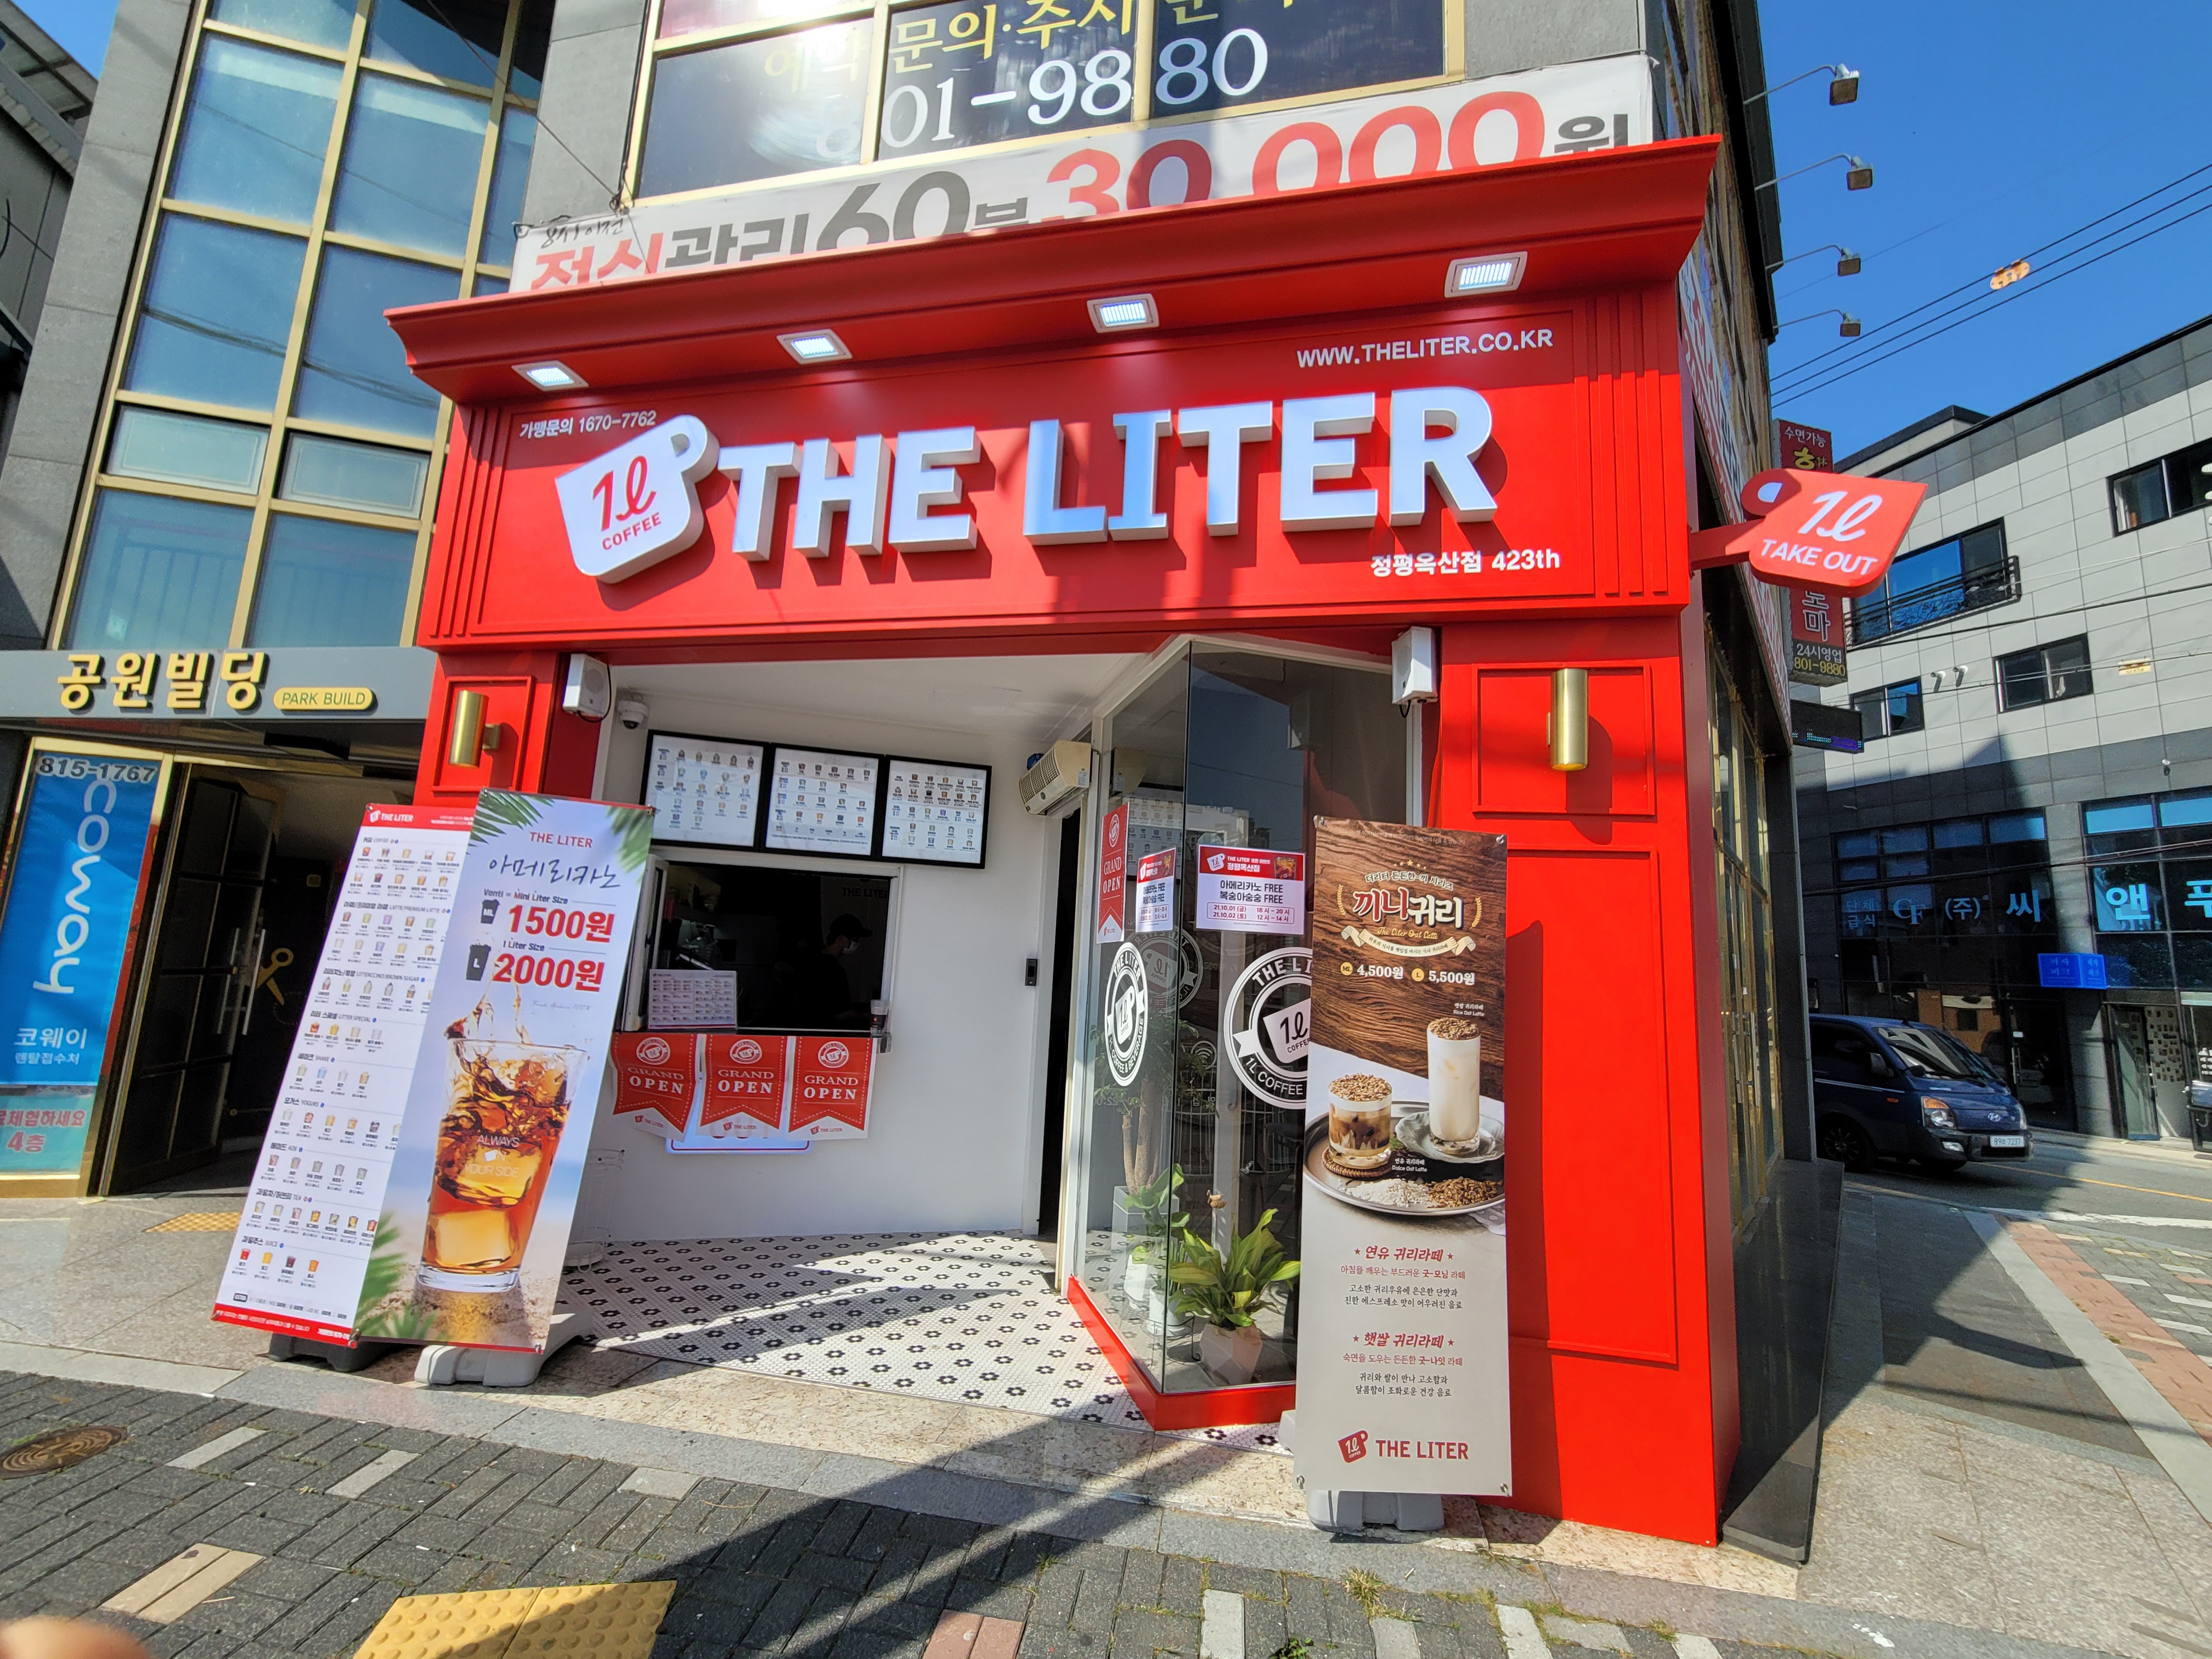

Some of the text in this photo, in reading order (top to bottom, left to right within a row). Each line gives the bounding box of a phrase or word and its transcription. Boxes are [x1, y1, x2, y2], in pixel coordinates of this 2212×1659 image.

[1297, 329, 1554, 368] WWW.THELITER.CO.KR
[520, 410, 657, 439] 가맹문의 1670-7762
[1785, 426, 1826, 448] 수면가능
[718, 386, 1498, 561] THE LITER
[601, 514, 662, 551] COFFEE
[1370, 549, 1561, 578] 정평옥산점 423th
[1760, 539, 1878, 575] TAKE OUT
[1797, 643, 1842, 664] 24시영업
[1794, 657, 1846, 676] 801-9880
[58, 652, 266, 710] 공원빌딩
[281, 692, 366, 706] PARK BUILD
[37, 757, 157, 783] 815-1767
[530, 832, 593, 848] THE LITER
[489, 854, 620, 889] 아메리카노
[1103, 856, 1122, 876] GRAND
[1227, 862, 1260, 872] 정평옥산점
[33, 778, 117, 994] coway
[1103, 876, 1121, 894] OPEN
[1220, 880, 1283, 893] 아메리카노 FREE
[1365, 872, 1454, 891] 더리터 시리즈
[483, 888, 568, 904] Venti Mini Liter Size
[842, 887, 861, 897] THE
[1220, 891, 1283, 904] 복숭아숭숭 FREE
[483, 907, 494, 917] ML
[1352, 887, 1464, 929] 끼니귀리
[1945, 897, 1980, 921] (주)
[509, 904, 615, 943] 1500원
[1377, 927, 1438, 940] The Liter Oat Latte
[508, 938, 545, 951] Liter Size
[473, 958, 481, 968] L
[1114, 952, 1141, 981] THE LITER
[492, 953, 605, 992] 2000원
[1252, 960, 1286, 986] THE
[1357, 964, 1404, 980] 4,500원
[1429, 970, 1475, 986] 5,500원
[14, 1027, 87, 1049] 코웨이
[1111, 1017, 1144, 1074] COFFEE BEVERAGE
[628, 1067, 684, 1080] GRAND
[718, 1069, 774, 1079] GRAND
[804, 1075, 859, 1086] GRAND
[1245, 1057, 1304, 1095] 1L COFFEE
[629, 1075, 684, 1094] OPEN
[718, 1080, 773, 1093] OPEN
[804, 1087, 857, 1099] OPEN
[6, 1131, 45, 1153] 4층
[476, 1135, 520, 1148] ALWAYS
[465, 1164, 520, 1178] YOUR SIDE
[1365, 1245, 1444, 1262] 연유 귀리라떼
[1341, 1265, 1466, 1279] 아침을 깨우는 부드러운 굿-모닝 라떼
[1349, 1284, 1458, 1297] 고소한 귀리우유에 은은한 단맛과
[1344, 1295, 1463, 1309] 진한 에스프레소 맛이 어우러진 음료
[1363, 1331, 1444, 1349] 햇쌀 귀리라떼
[1342, 1352, 1463, 1367] 숙면을 도우는 든든한 굿-나잇 라떼
[1359, 1372, 1448, 1385] 귀리와 쌀이 만나 고소함과
[1355, 1384, 1452, 1397] 달콤함이 조화로운 건강 음료
[1348, 1450, 1361, 1459] COFFEE
[1375, 1440, 1469, 1460] THE LITER
